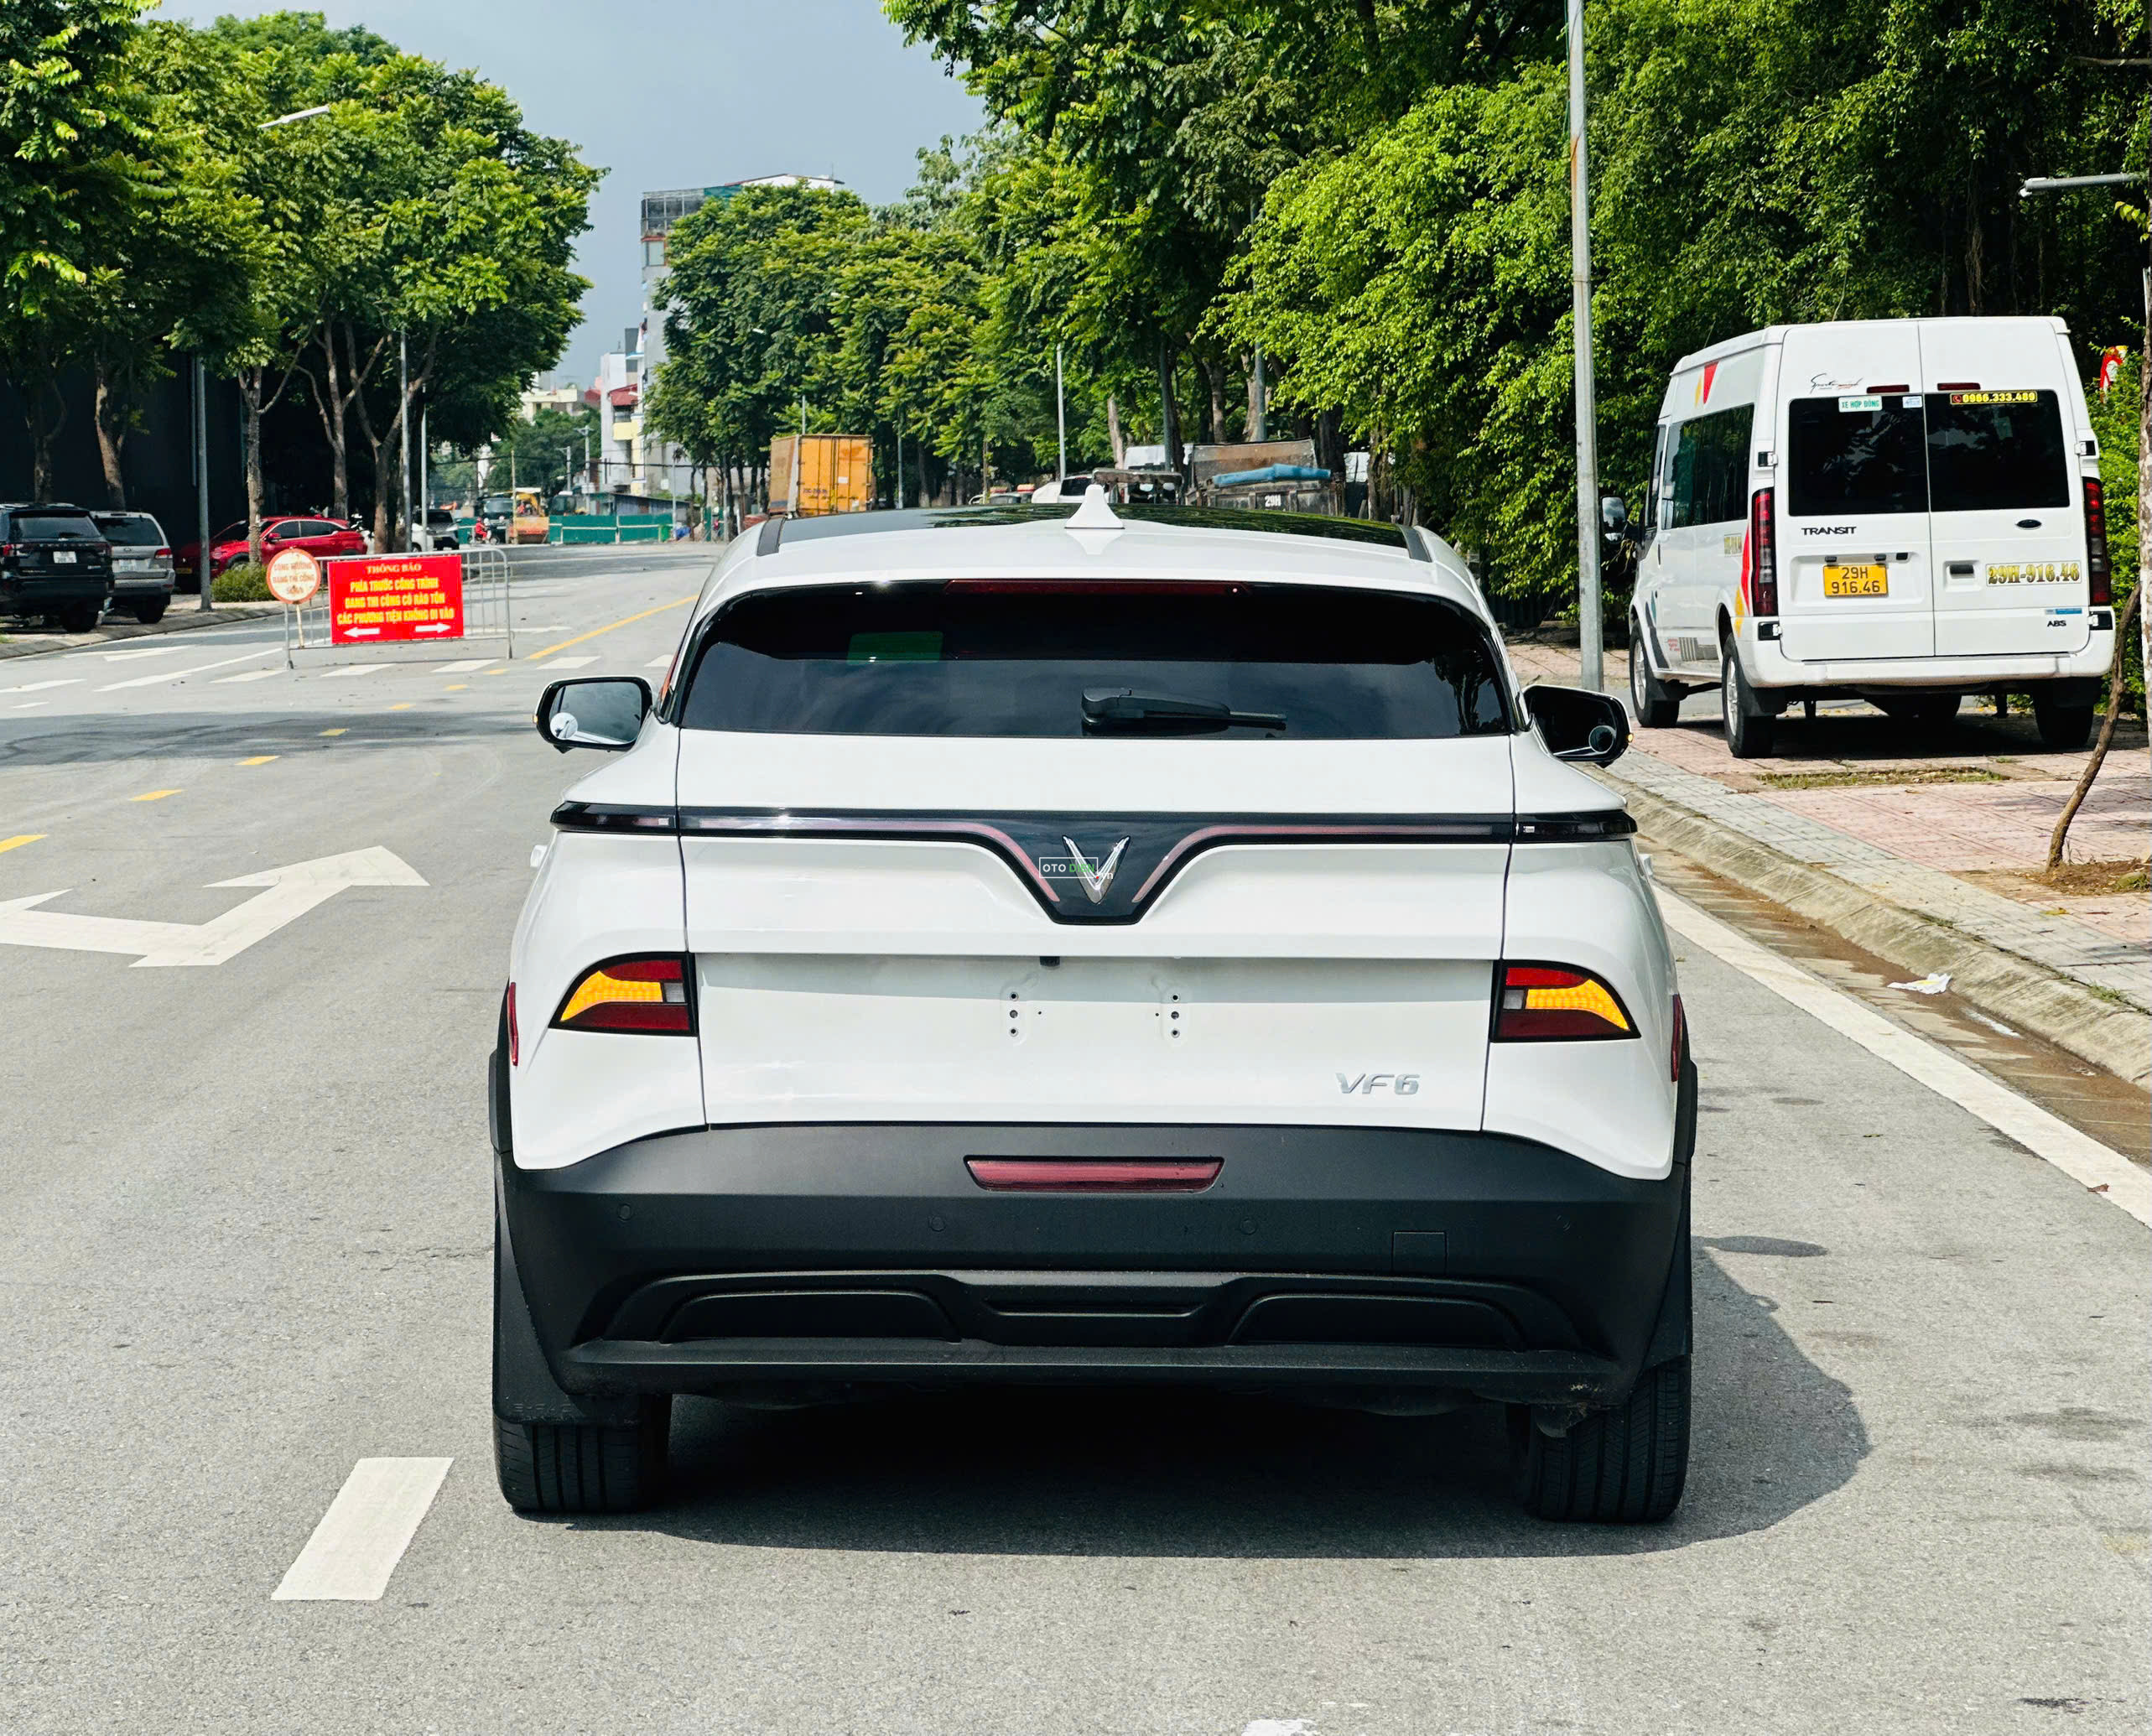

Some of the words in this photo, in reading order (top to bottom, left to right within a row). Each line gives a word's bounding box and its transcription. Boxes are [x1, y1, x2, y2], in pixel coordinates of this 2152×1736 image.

[1265, 494, 1281, 507] 29H
[1801, 527, 1857, 535] TRANSIT
[366, 563, 400, 574] THÔNG
[402, 561, 422, 572] BÁO
[1842, 566, 1869, 580] 29H
[1988, 563, 2080, 584] 29H-916.46
[350, 579, 368, 592] PHÍA
[395, 576, 415, 590] CÔNG
[1831, 580, 1880, 594] 916.46
[366, 595, 379, 608] THI
[380, 593, 401, 607] CÔNG
[402, 592, 413, 606] CÓ
[336, 611, 353, 625] CÁC
[439, 606, 455, 620] VÀO
[1335, 1073, 1421, 1095] VF6
